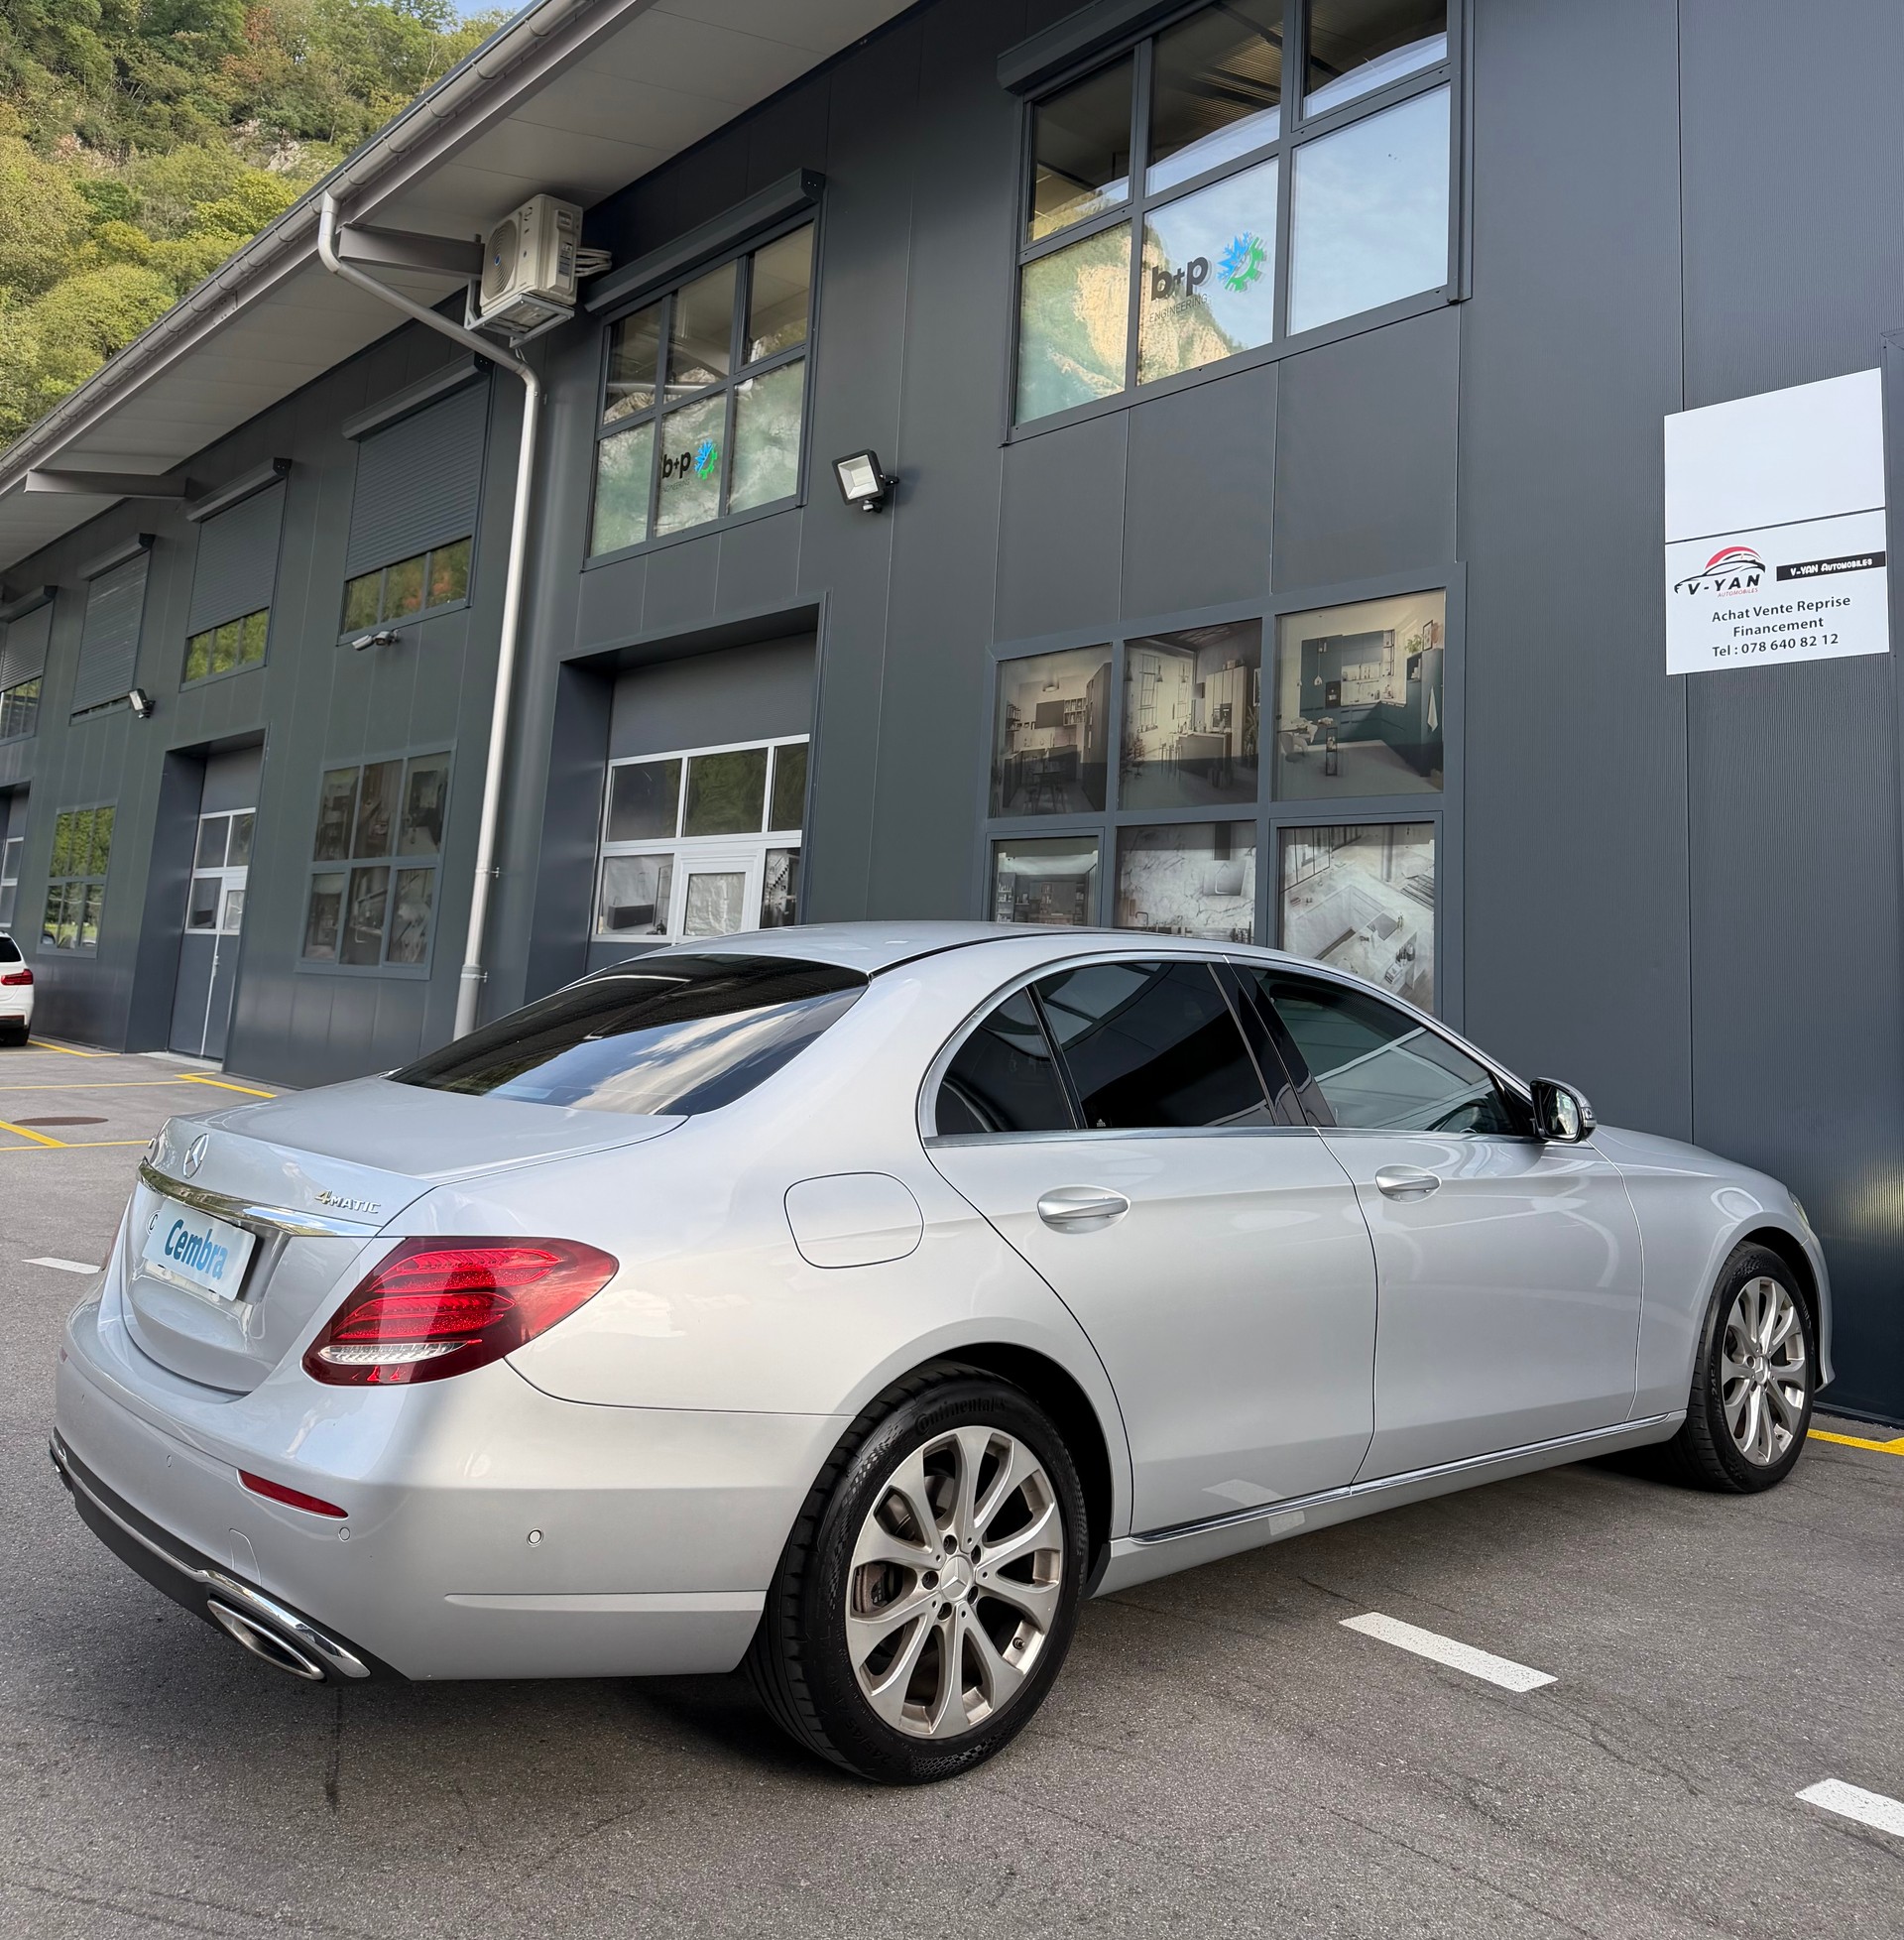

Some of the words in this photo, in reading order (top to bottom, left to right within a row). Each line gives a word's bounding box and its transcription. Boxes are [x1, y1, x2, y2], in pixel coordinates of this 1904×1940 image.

[1149, 294, 1208, 322] ENGINEERING
[1790, 563, 1819, 576] V-YAN
[1717, 588, 1759, 598] AUTOMOBILES
[1712, 609, 1750, 623] Achat
[1753, 604, 1793, 617] Vente
[1797, 596, 1851, 613] Reprise
[1733, 617, 1825, 638] Financement
[1712, 645, 1730, 658] Tel
[1740, 641, 1767, 655] 078
[1770, 638, 1796, 651] 640
[1800, 635, 1817, 648] 82
[1822, 633, 1839, 646] 12
[164, 1219, 229, 1280] Cembra
